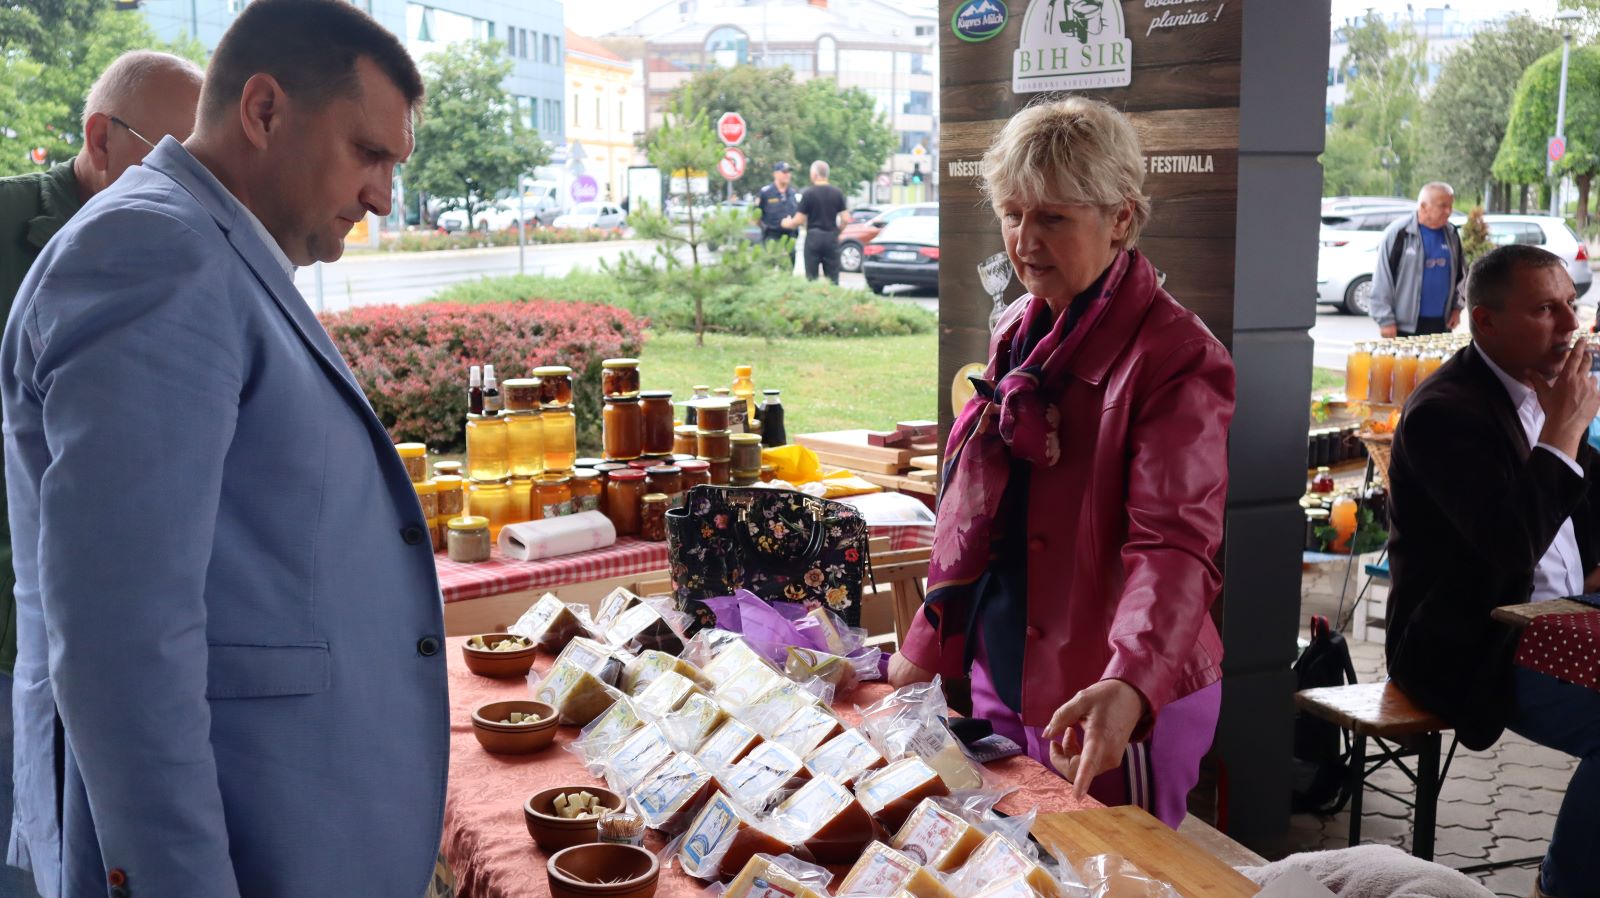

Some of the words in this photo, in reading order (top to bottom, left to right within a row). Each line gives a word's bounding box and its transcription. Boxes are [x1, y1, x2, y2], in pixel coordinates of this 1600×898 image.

[958, 17, 981, 29] Kupres
[982, 12, 1003, 25] Milch
[1146, 10, 1209, 37] planina
[1020, 47, 1068, 72] BIH
[1080, 41, 1125, 67] SIR
[1151, 155, 1214, 173] FESTIVALA
